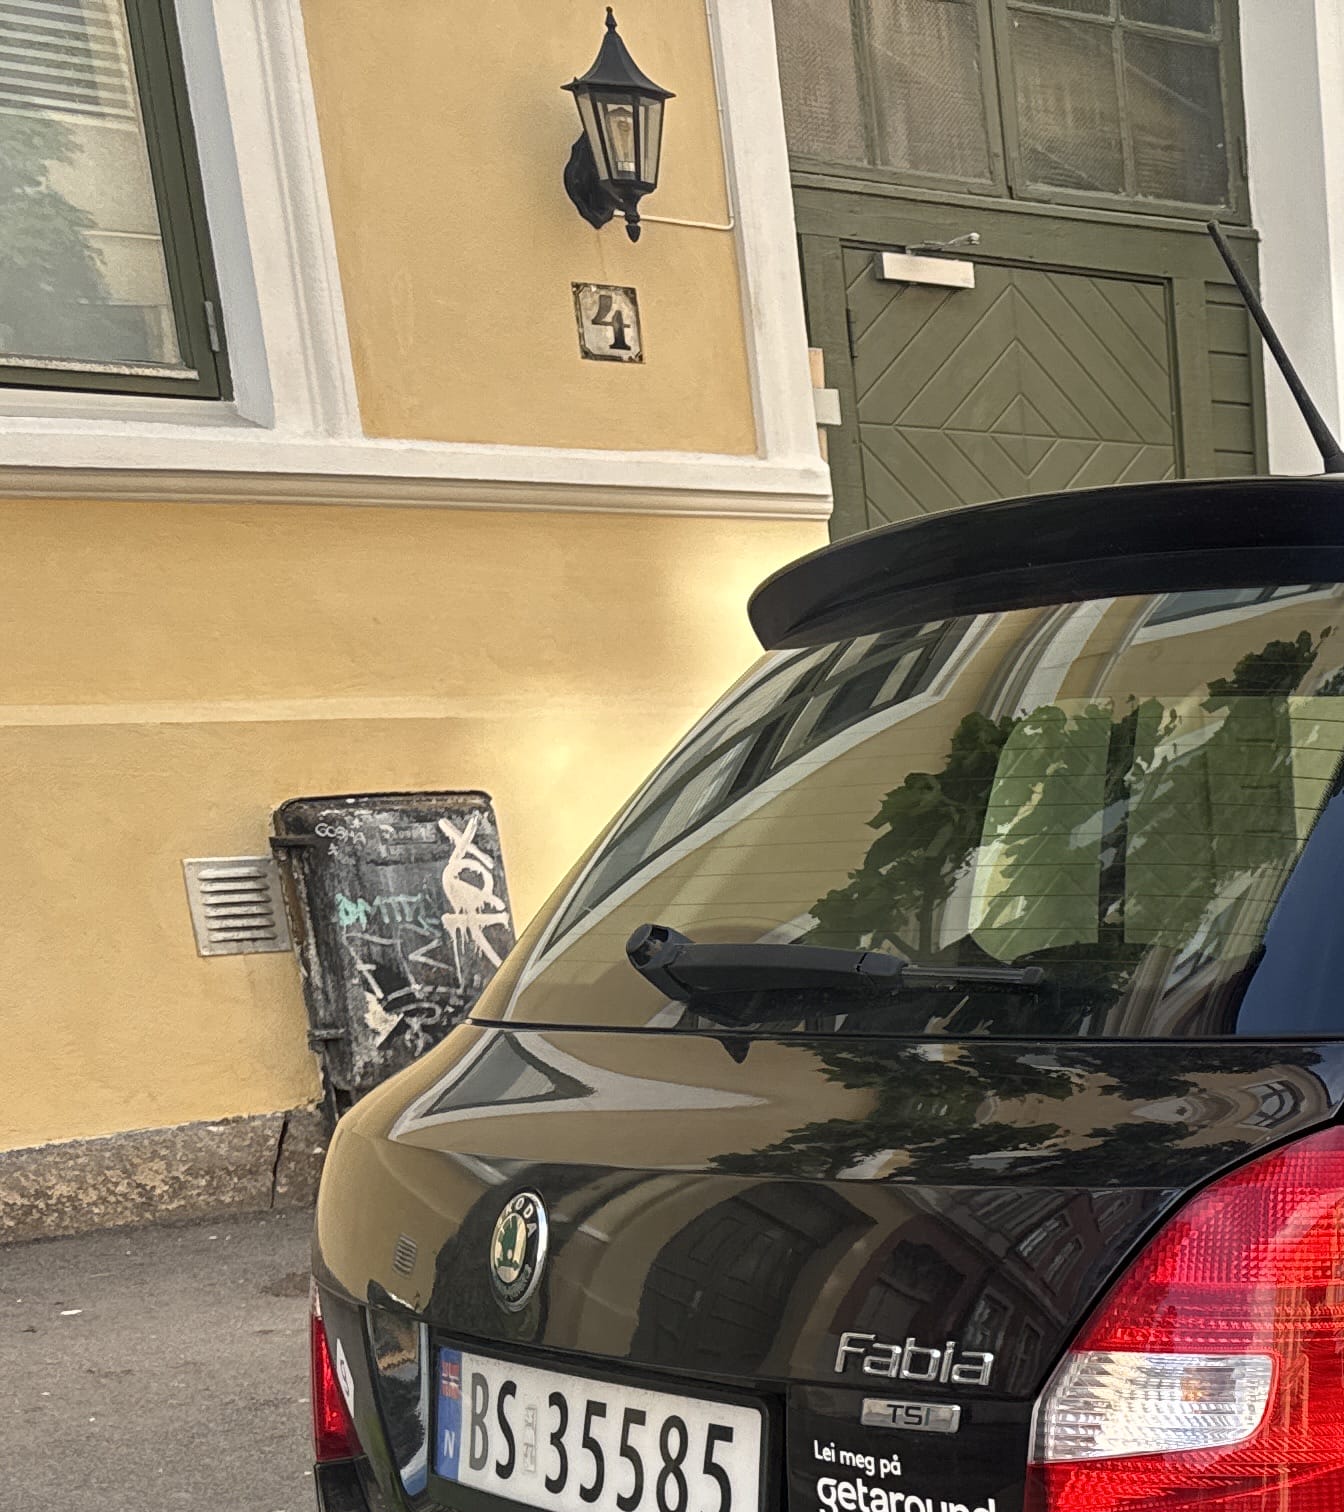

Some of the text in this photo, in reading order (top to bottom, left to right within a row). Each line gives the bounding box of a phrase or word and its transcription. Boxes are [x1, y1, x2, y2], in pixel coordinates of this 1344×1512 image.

[591, 294, 631, 351] 4
[834, 1331, 994, 1386] Fabia
[443, 1429, 456, 1459] N
[469, 1372, 518, 1479] BS
[886, 1404, 931, 1426] TSI
[813, 1439, 902, 1478] Lei meg på
